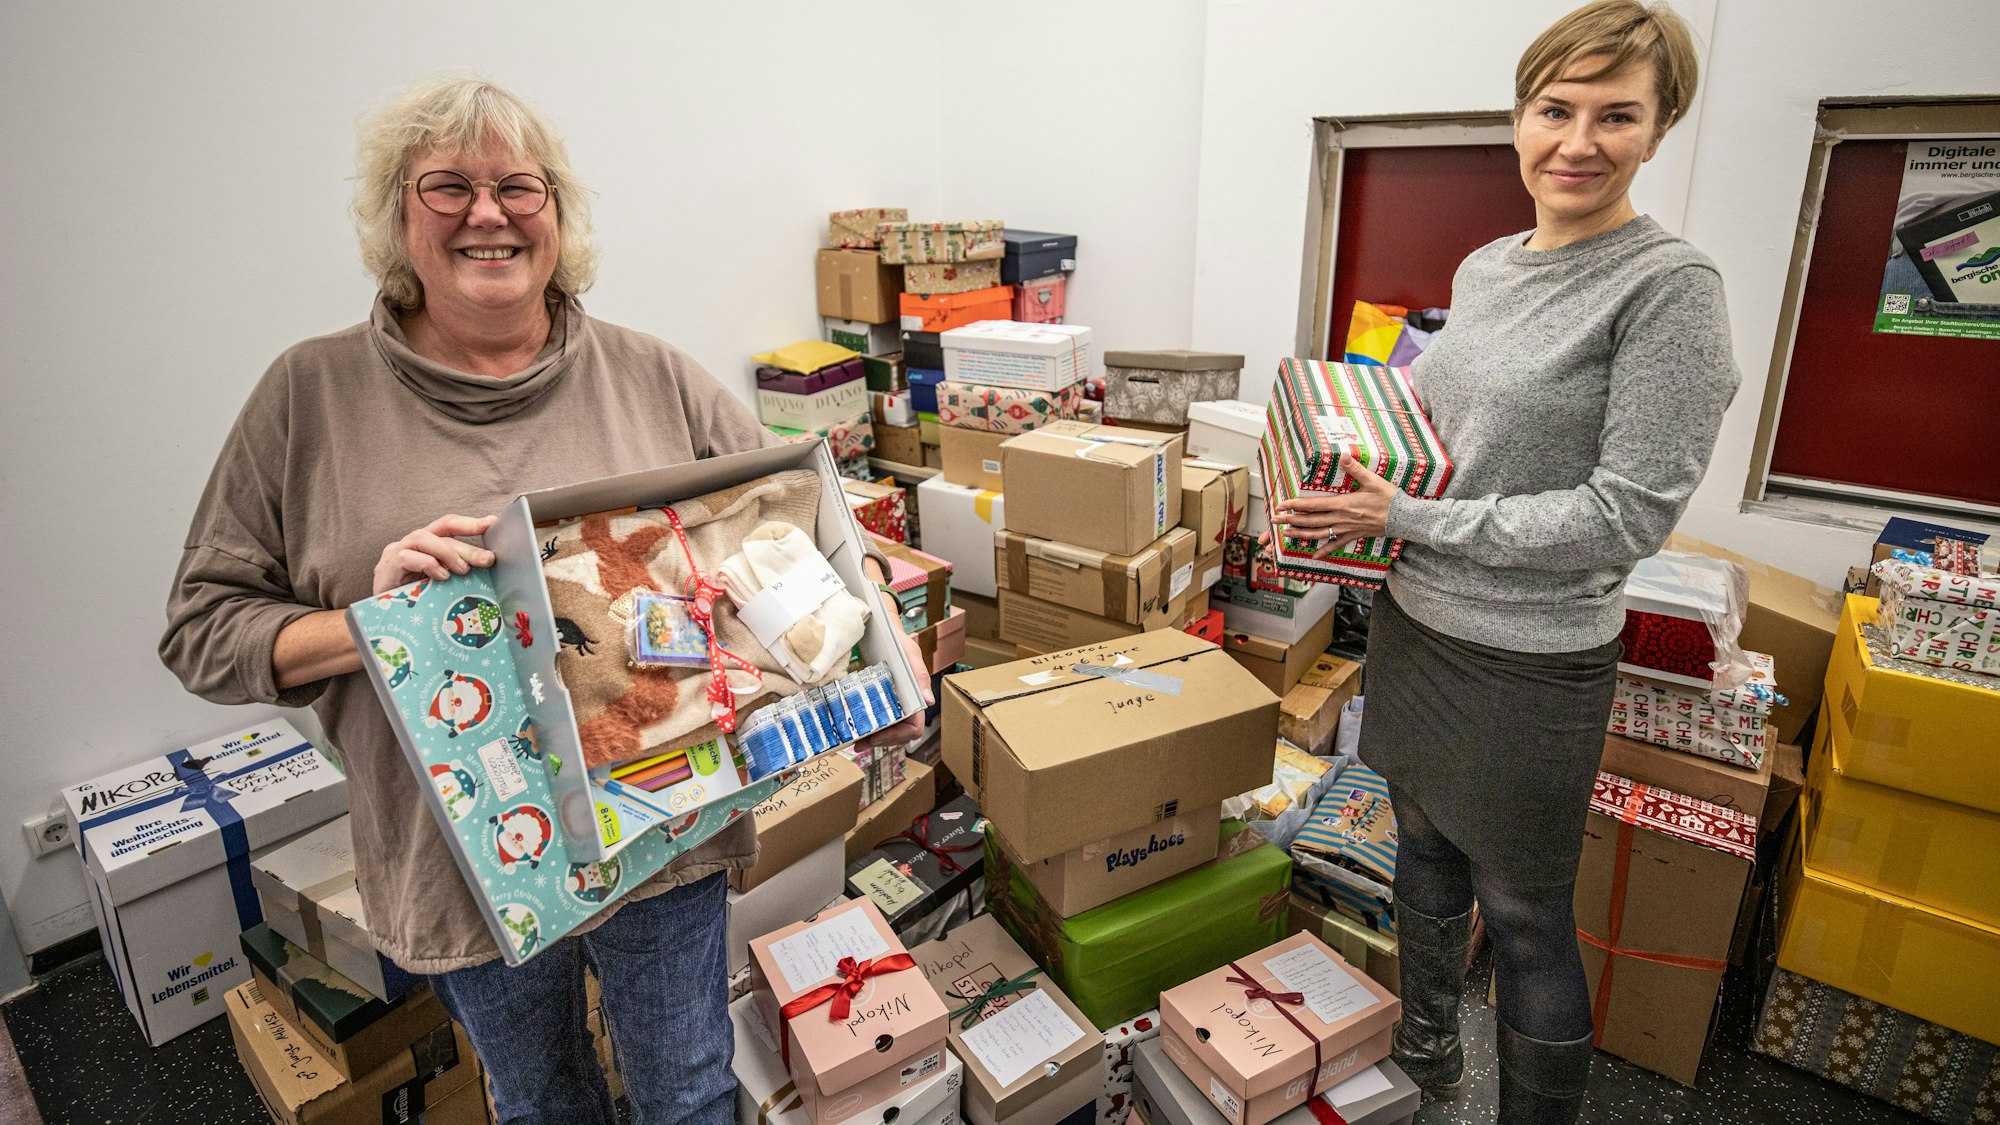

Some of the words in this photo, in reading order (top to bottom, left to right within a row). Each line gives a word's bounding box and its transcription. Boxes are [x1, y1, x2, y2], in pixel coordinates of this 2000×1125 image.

[1928, 146, 1996, 159] Digitale
[1909, 160, 1967, 170] immer
[1951, 263, 1998, 284] bergische
[763, 395, 804, 411] DIVINO
[815, 385, 861, 410] DIVINO
[386, 624, 421, 648] Christmas
[1030, 644, 1110, 666] NIKOPOL
[1104, 693, 1155, 715] Junge
[1612, 701, 1628, 735] MERR
[222, 739, 242, 750] Wir
[1732, 734, 1765, 749] STM
[227, 772, 259, 788] FOR
[268, 750, 316, 773] FAMILY
[235, 773, 277, 792] WITH
[287, 757, 317, 774] KIDS
[791, 767, 840, 797] UNISEX
[135, 818, 163, 832] Ihre
[600, 806, 612, 825] 8+1
[110, 819, 204, 859] überraschung
[112, 815, 194, 849] Weihnachts-
[907, 849, 929, 865] akes
[1106, 829, 1185, 873] Playshoes
[514, 889, 547, 912] Christmas
[152, 957, 239, 1004] Lebensmittel.
[168, 962, 192, 982] Wir
[846, 992, 914, 1038] Nikopol
[1210, 1001, 1284, 1058] Nikopol
[1285, 1051, 1358, 1101] Graeland
[398, 1087, 409, 1124] amazon
